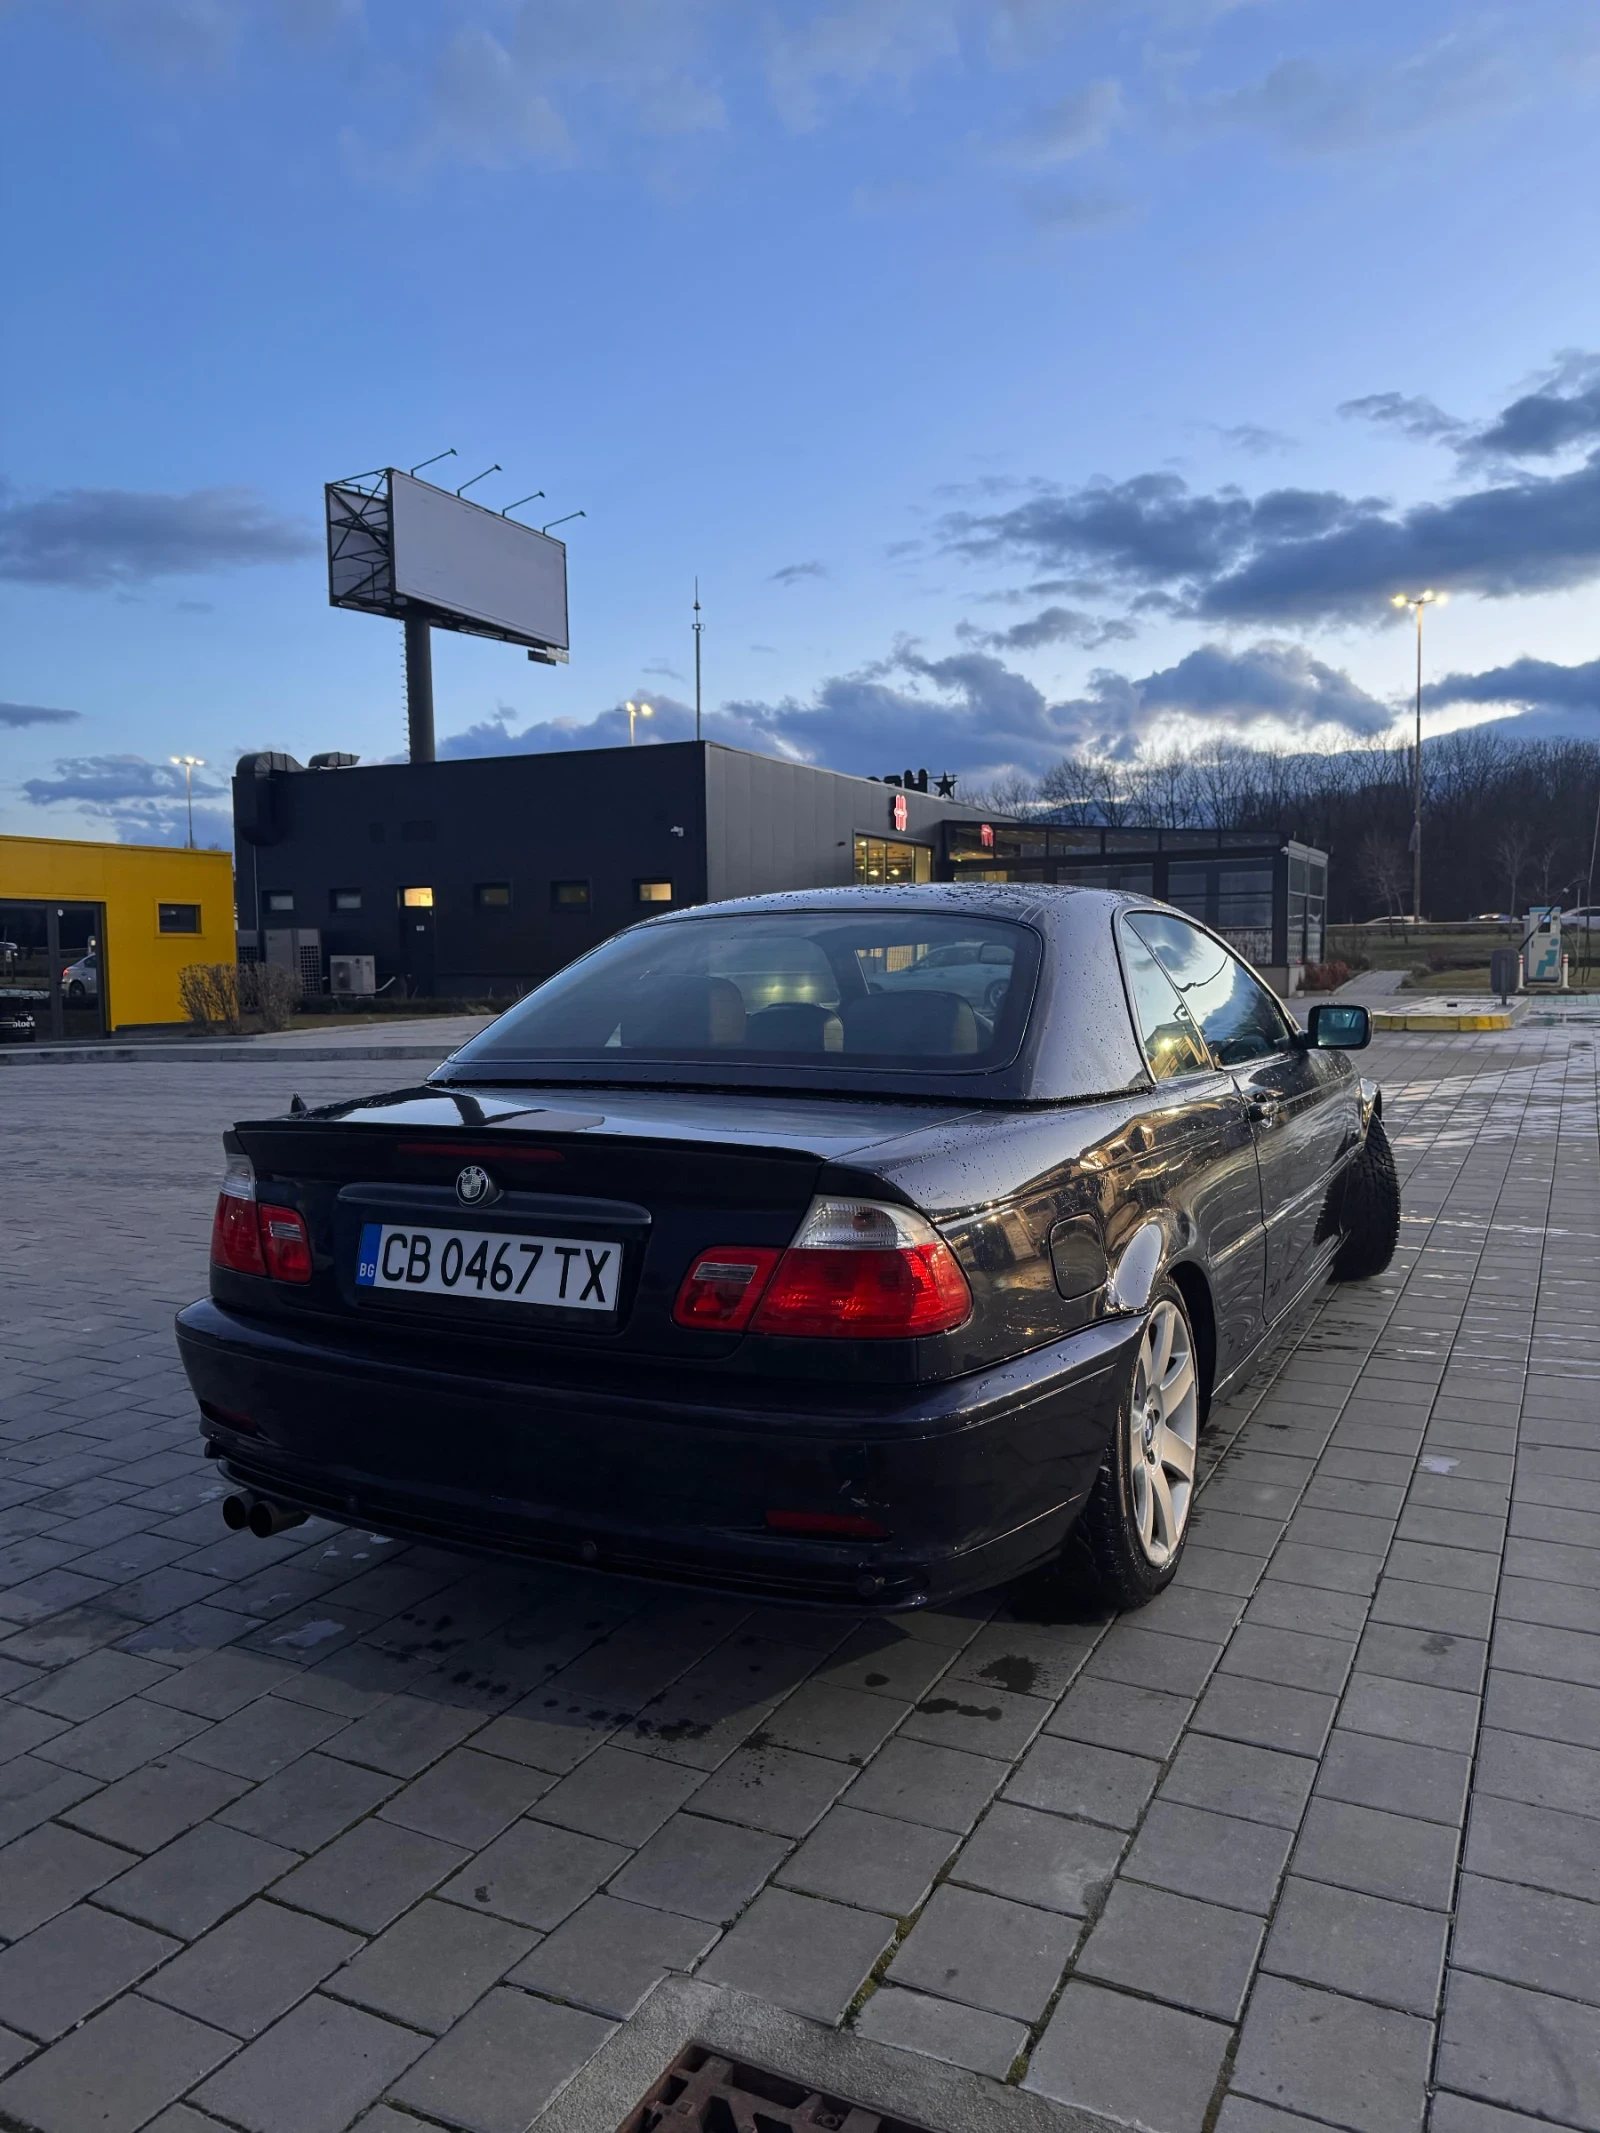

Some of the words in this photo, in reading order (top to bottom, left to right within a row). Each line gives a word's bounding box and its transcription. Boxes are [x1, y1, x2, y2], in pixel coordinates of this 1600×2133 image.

[359, 1263, 374, 1278] BG
[382, 1233, 431, 1283] CB
[441, 1238, 543, 1294] 0467
[554, 1246, 611, 1302] TX
